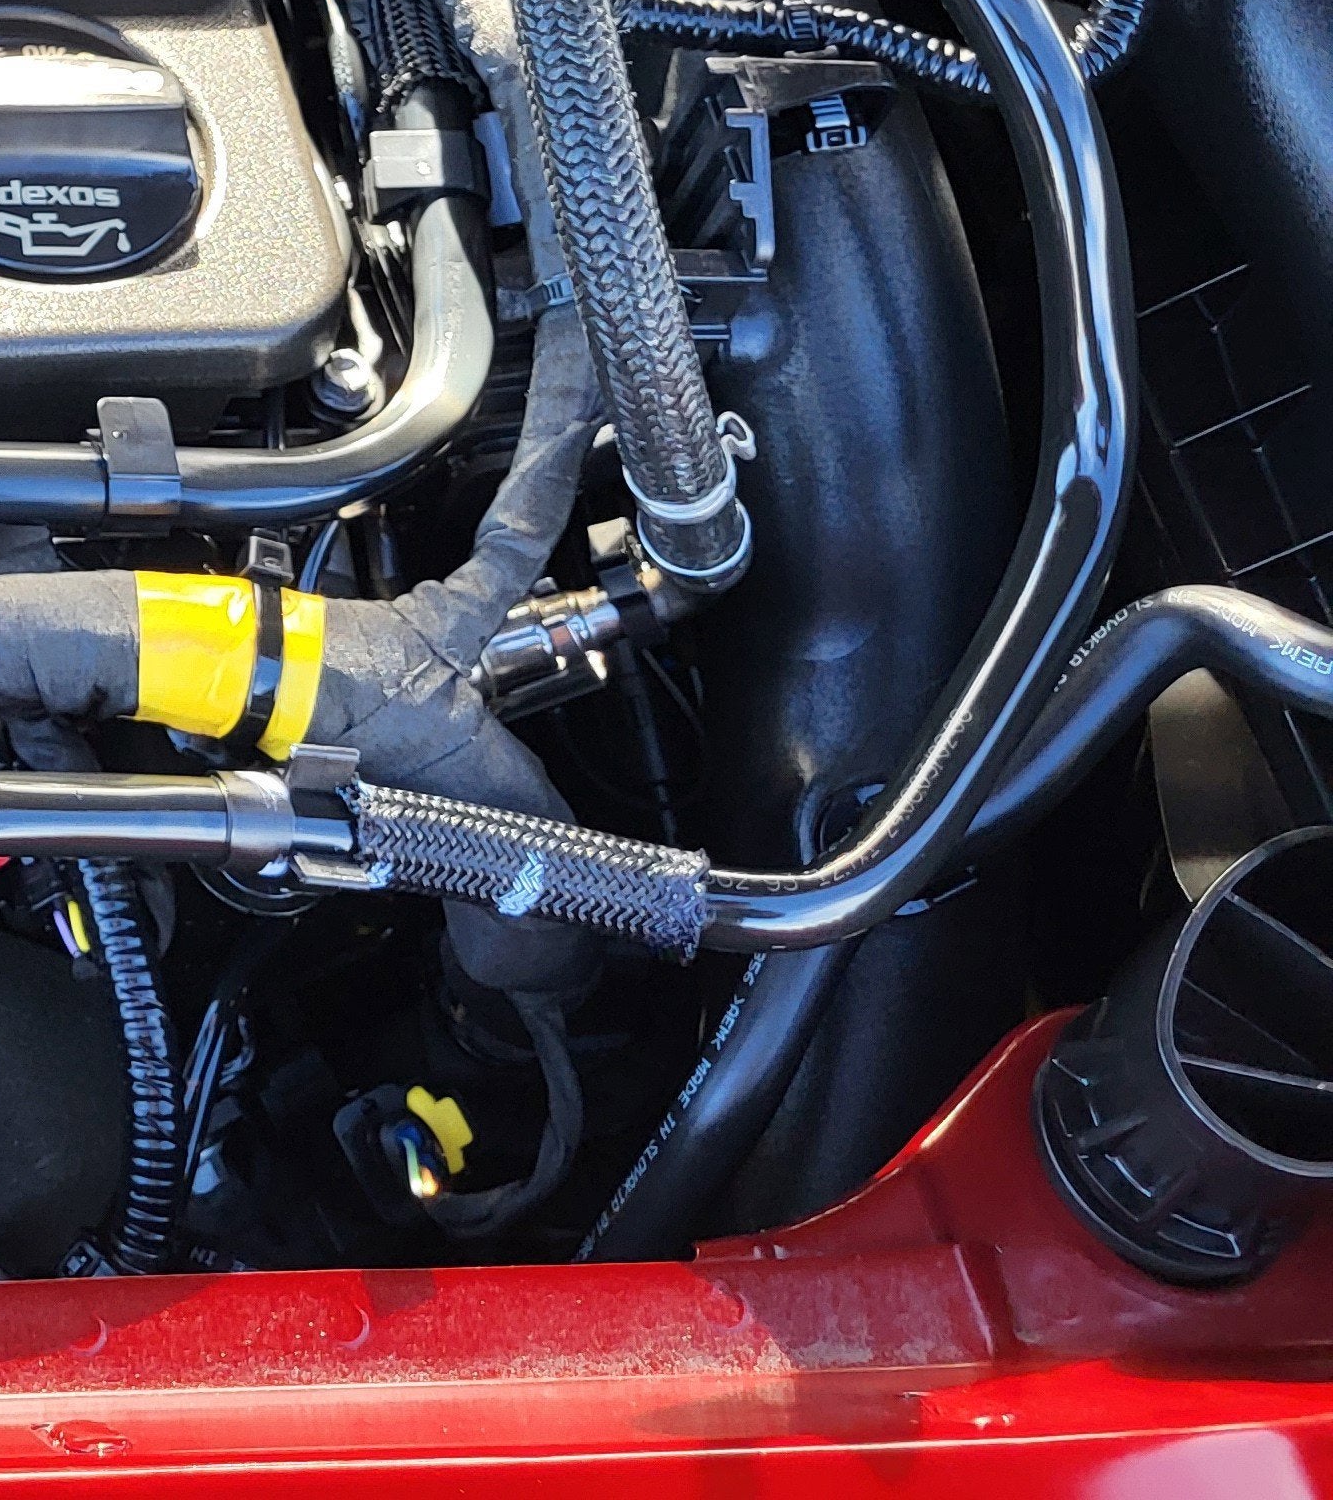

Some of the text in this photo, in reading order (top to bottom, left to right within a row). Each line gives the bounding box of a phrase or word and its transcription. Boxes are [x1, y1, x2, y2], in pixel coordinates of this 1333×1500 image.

[1069, 596, 1154, 668] SLOVAKIA
[678, 1057, 712, 1109] MADE
[659, 1112, 676, 1140] IN
